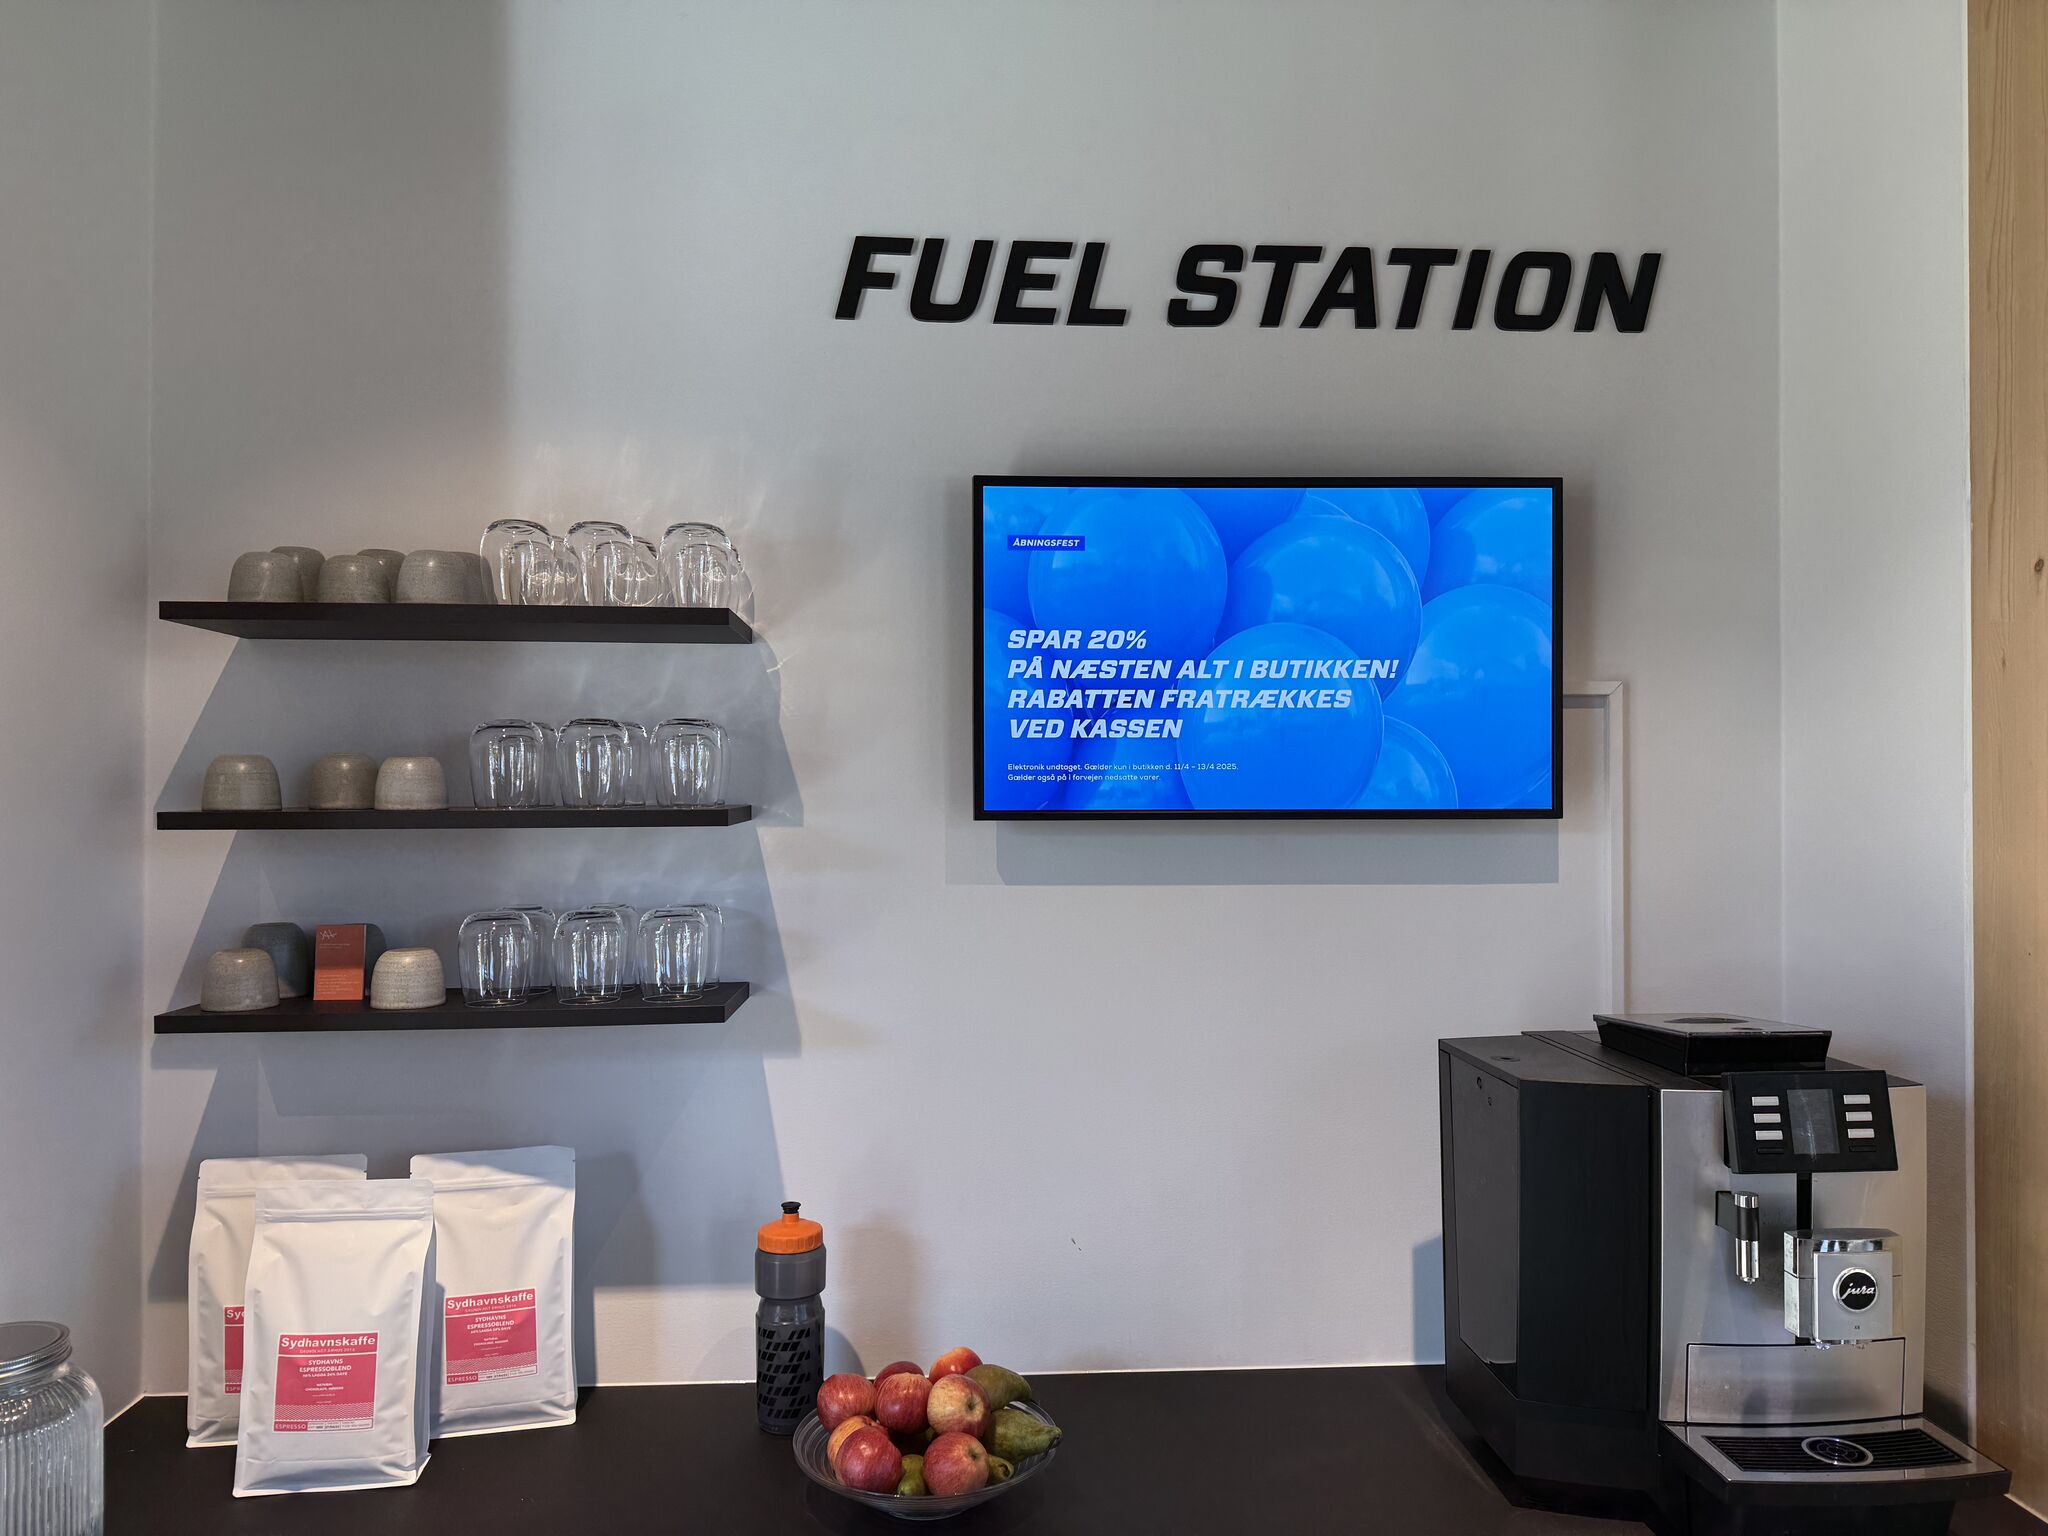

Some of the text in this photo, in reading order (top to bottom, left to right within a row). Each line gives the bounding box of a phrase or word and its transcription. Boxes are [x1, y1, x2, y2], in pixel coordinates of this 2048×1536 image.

[835, 236, 1663, 333] FUEL STATION
[1012, 537, 1080, 547] ÅBNINGSFEST
[1007, 630, 1147, 649] SPAR 20%
[1007, 656, 1399, 679] PÅ NÆSTEN ALT I BUTIKKEN!
[1007, 689, 1352, 709] RABATTEN FRATRÆKKES
[1009, 719, 1183, 739] VED KASSEN
[1007, 763, 1045, 771] Elektronik
[1046, 763, 1083, 772] undtaget.
[1084, 763, 1113, 771] Gælder
[1007, 773, 1036, 781] Gælder
[1037, 773, 1056, 783] også
[1057, 773, 1067, 783] på
[1072, 773, 1103, 783] forvejen
[1841, 1283, 1876, 1300] jura
[447, 1292, 533, 1310] Sydhavnskaffe
[475, 1314, 507, 1323] SYDHAVNS
[466, 1320, 515, 1330] ESPRESSOBLEND
[281, 1336, 376, 1349] Sydhavnskaffe
[308, 1358, 344, 1366] SYDHAVNS
[299, 1365, 352, 1373] ESPRESSOBLEND
[447, 1375, 478, 1384] ESPRESSO
